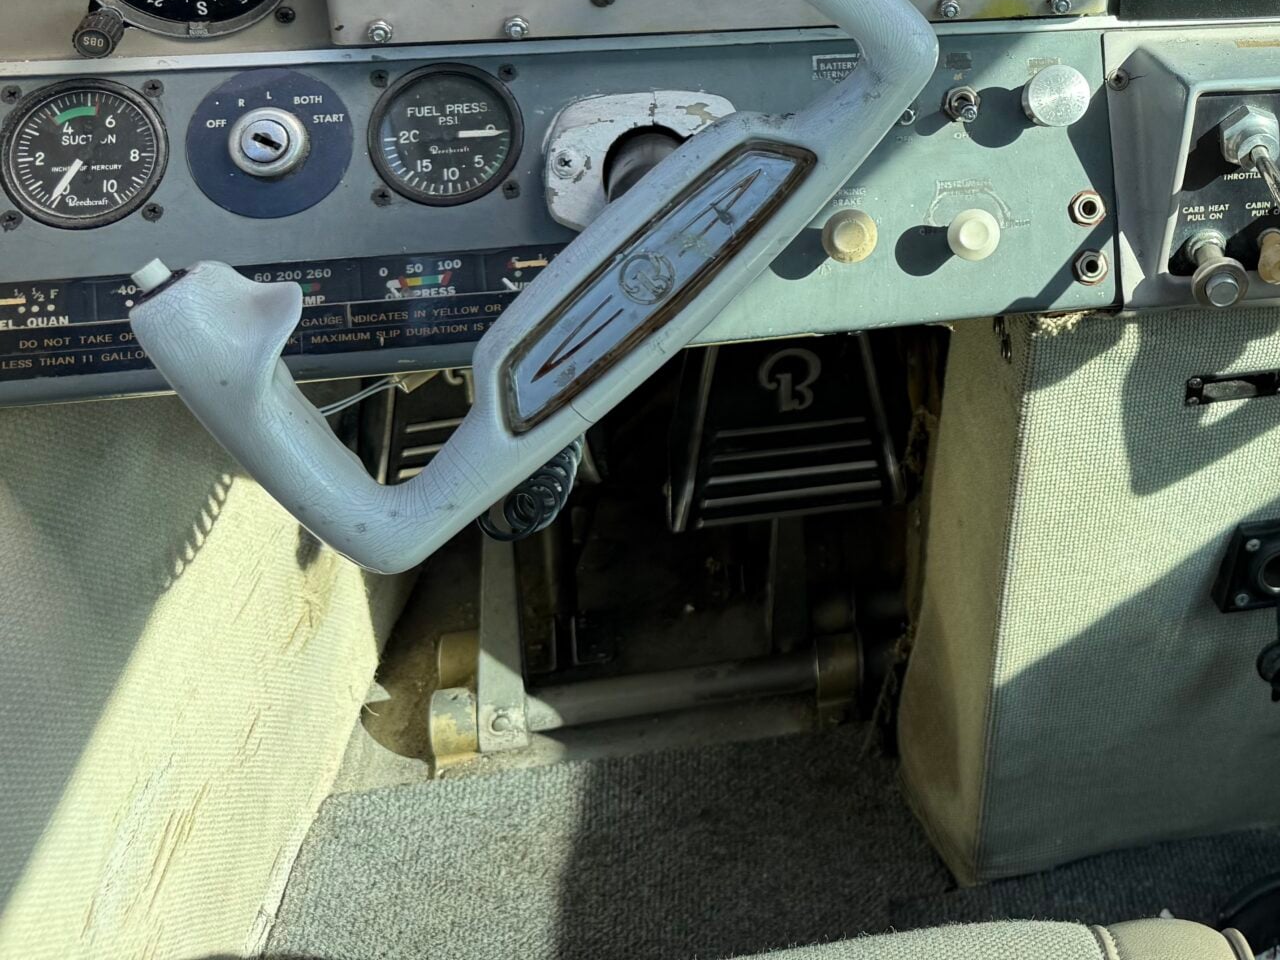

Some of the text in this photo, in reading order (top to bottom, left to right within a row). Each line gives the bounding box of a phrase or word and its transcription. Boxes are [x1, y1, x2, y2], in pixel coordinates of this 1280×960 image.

[196, 1, 208, 15] S
[820, 61, 858, 71] BATTERY
[238, 99, 245, 107] R
[293, 95, 323, 105] BOTH
[407, 106, 440, 117] FUEL
[206, 119, 227, 128] OFF
[313, 113, 344, 124] START
[62, 134, 116, 145] SUCTN
[66, 195, 108, 206] Beechcraft
[1182, 203, 1229, 214] CARB HEAT
[1187, 213, 1206, 221] PULL
[406, 259, 462, 274] 50 100
[50, 289, 59, 299] F
[301, 303, 502, 327] GAUGE NDICATES IN YELLOW OR
[311, 332, 370, 344] MAXIMUM
[376, 329, 400, 339] SLIP
[406, 324, 468, 336] DURATION
[19, 334, 113, 349] DO NOT TAKE
[2, 360, 32, 369] LESS
[40, 356, 75, 366] THAN
[82, 355, 93, 363] 11
